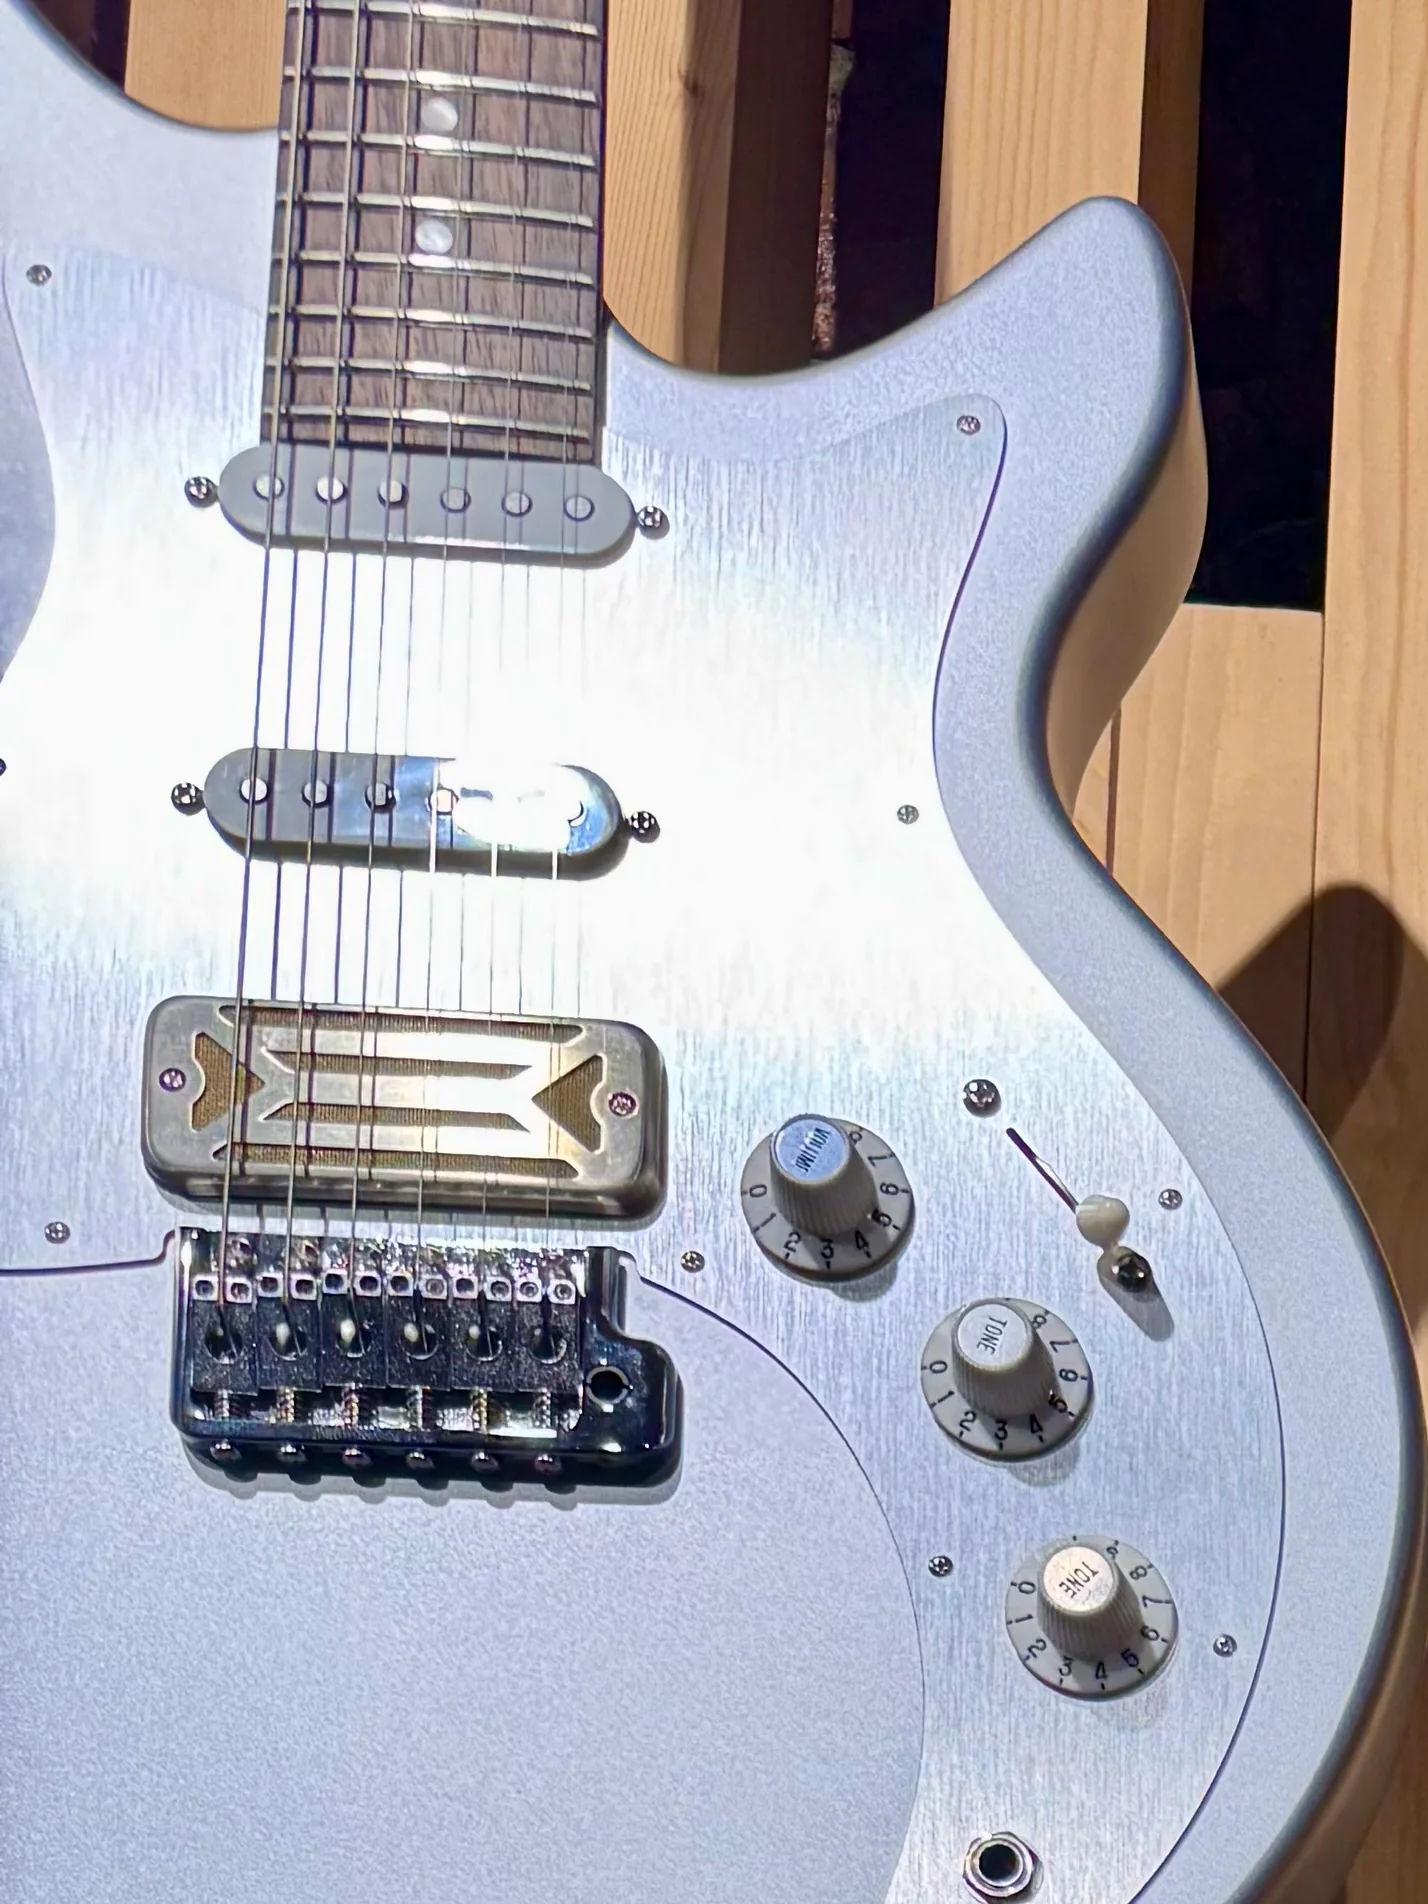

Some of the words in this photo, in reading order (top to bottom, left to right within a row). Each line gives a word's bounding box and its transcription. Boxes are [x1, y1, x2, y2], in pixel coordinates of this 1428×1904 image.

[867, 1154, 887, 1167] 7
[750, 1184, 767, 1197] 0
[880, 1182, 899, 1196] 6
[871, 1208, 892, 1227] 5
[784, 1231, 801, 1253] 2
[820, 1239, 834, 1259] 3
[854, 1230, 869, 1250] 4
[1032, 1314, 1047, 1329] 8
[977, 1316, 1007, 1354] TONE
[1049, 1340, 1070, 1353] 7
[929, 1360, 948, 1374] 0
[1059, 1368, 1079, 1382] 6
[1049, 1393, 1068, 1412] 5
[960, 1410, 977, 1432] 2
[994, 1419, 1008, 1441] 3
[1030, 1413, 1043, 1434] 4
[1058, 1561, 1099, 1599] TONE
[1129, 1565, 1148, 1580] 8
[1018, 1581, 1036, 1595] 0
[1142, 1595, 1162, 1608] 7
[1140, 1625, 1160, 1641] 6
[1028, 1638, 1047, 1658] 2
[1059, 1655, 1074, 1676] 3
[1120, 1648, 1140, 1668] 5
[1095, 1660, 1107, 1681] 4
